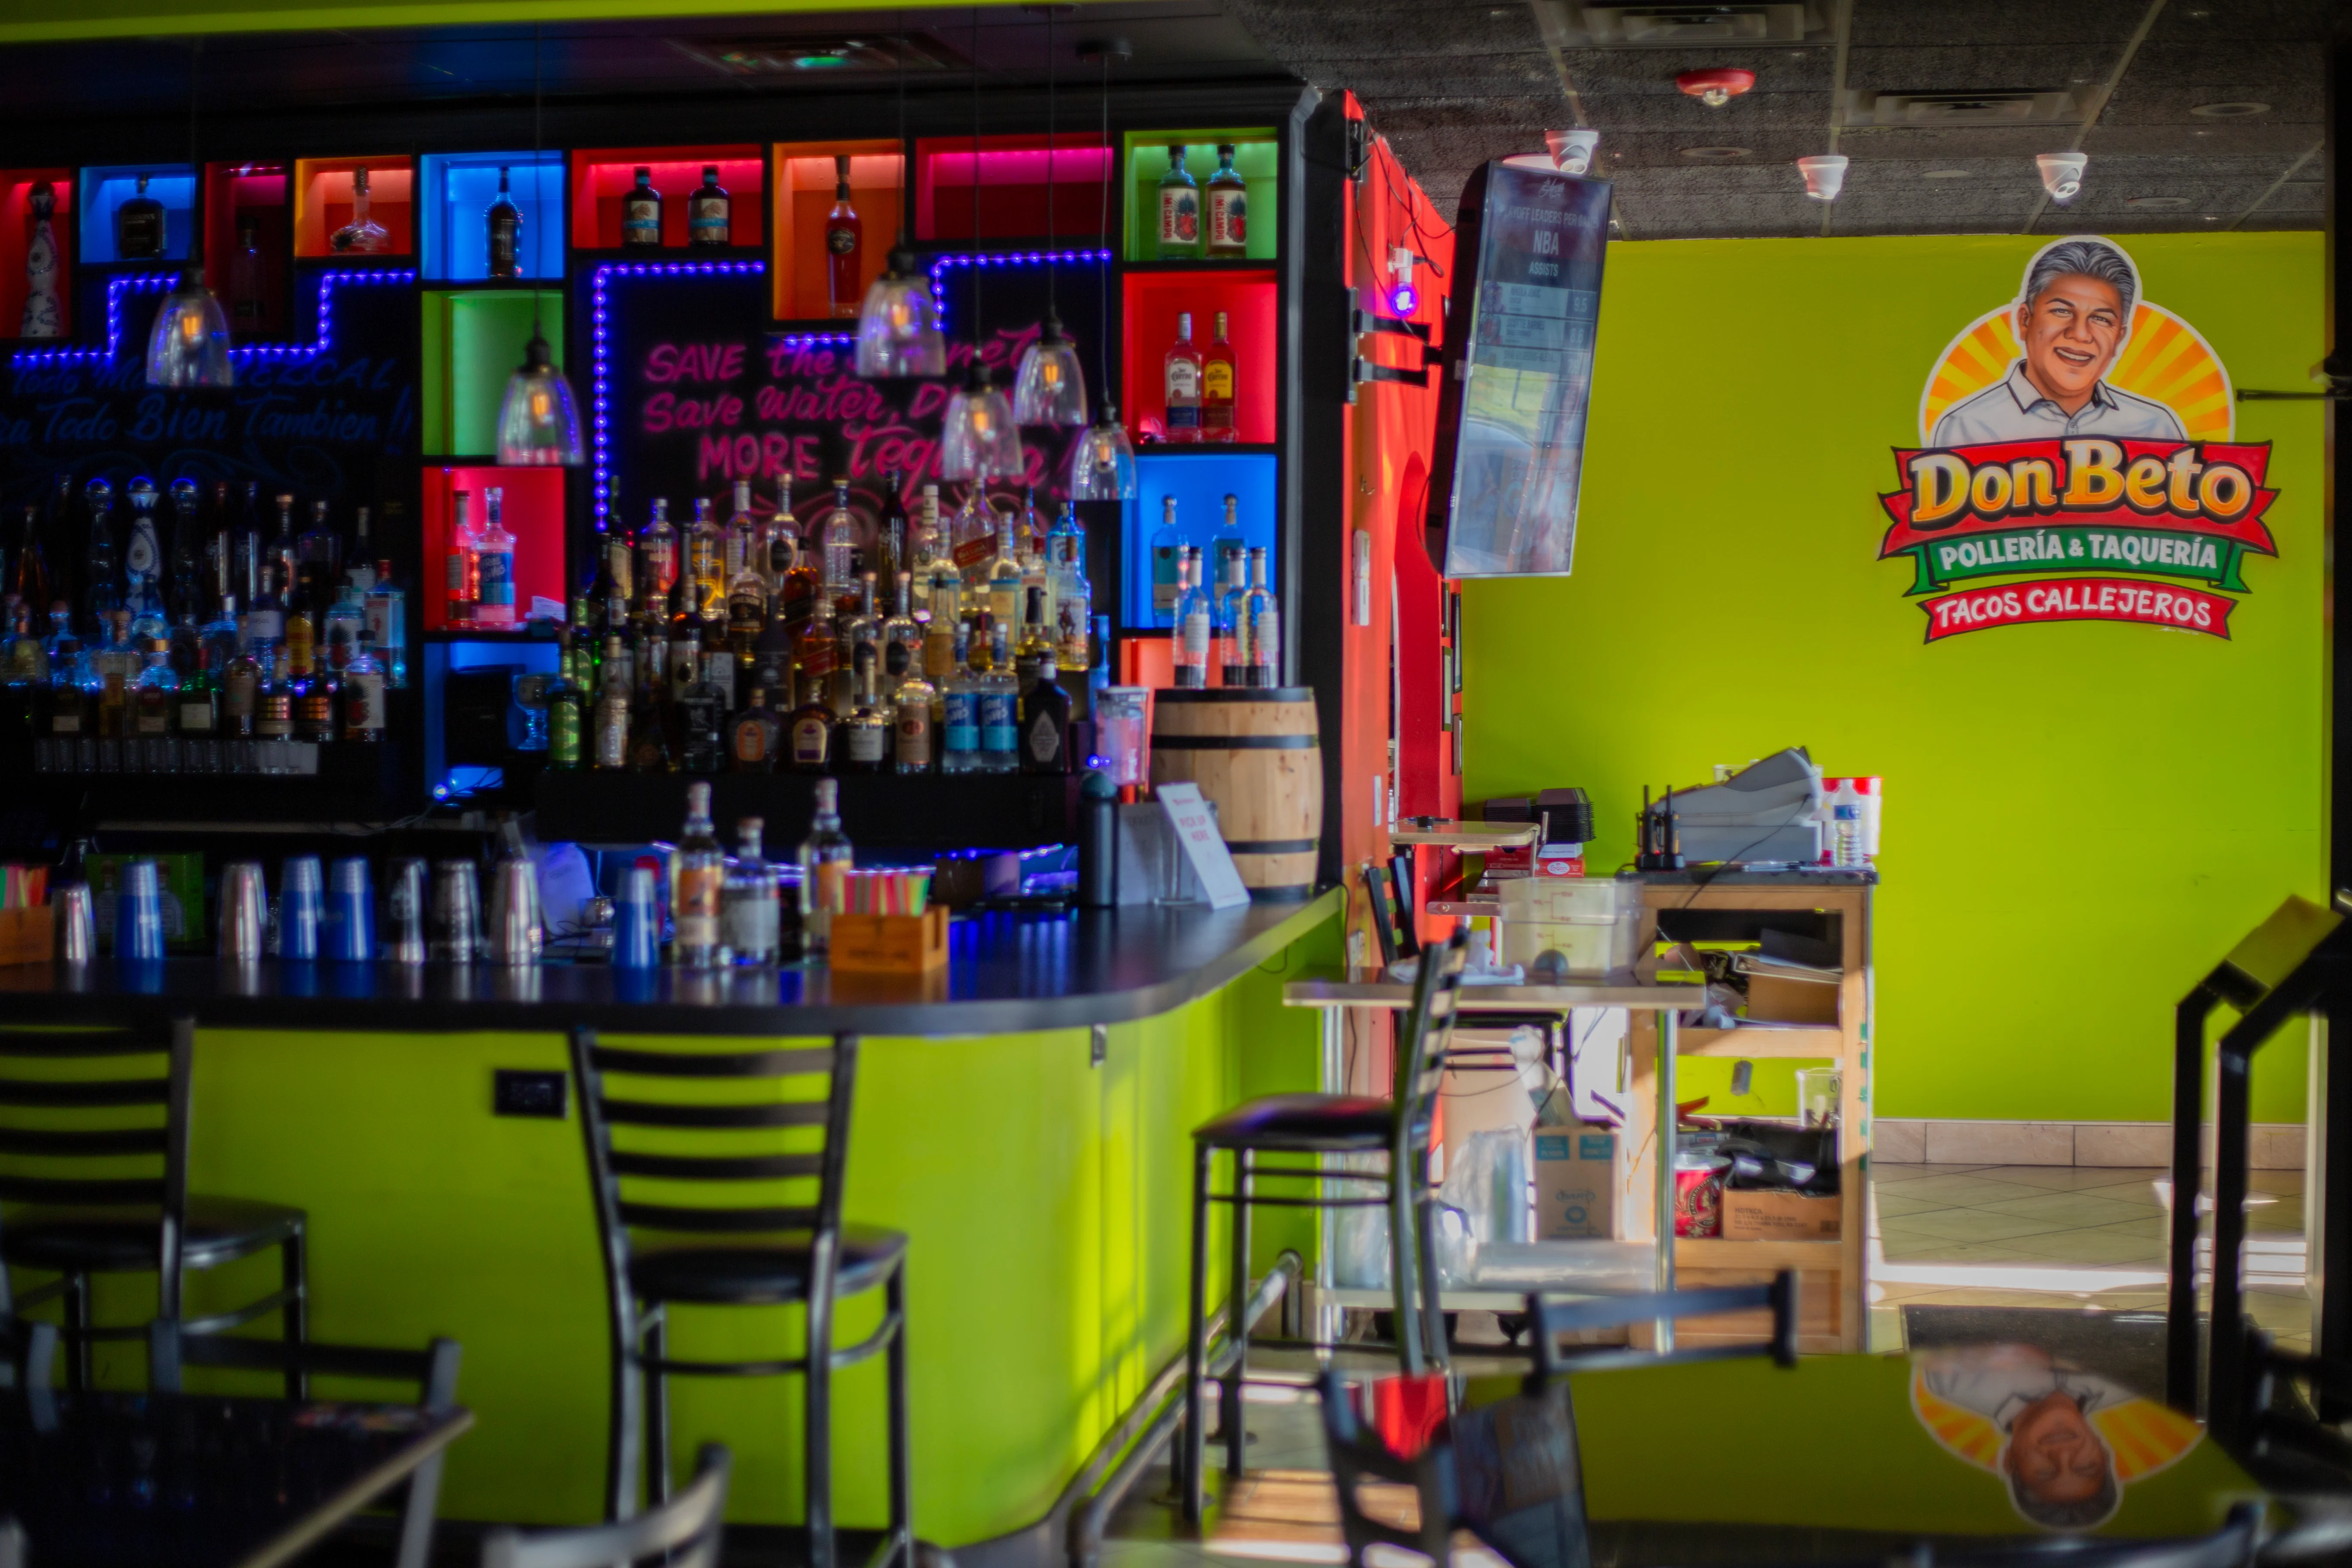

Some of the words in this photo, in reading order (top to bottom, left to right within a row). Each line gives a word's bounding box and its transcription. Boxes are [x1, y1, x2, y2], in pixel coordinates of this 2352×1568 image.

[1164, 209, 1172, 238] CAMPO
[1215, 211, 1225, 240] CAMPO
[1531, 208, 1561, 224] LEADERS
[1563, 212, 1577, 225] PER
[1533, 230, 1559, 255] NBA
[1529, 261, 1559, 276] ASSISTS
[644, 344, 747, 383] SAVE
[766, 342, 834, 379] the
[36, 392, 116, 443] Todo
[127, 392, 228, 442] Bien
[643, 391, 743, 433] Save
[696, 432, 820, 482] MORE
[1912, 453, 2057, 522] Don
[2063, 439, 2251, 516] Beto
[1940, 530, 2065, 570] POLLERÍA
[2068, 539, 2084, 557] &
[2088, 534, 2217, 569] TAQUERÍA
[1936, 592, 2021, 628] TACOS
[2027, 586, 2211, 626] CALLEJEROS
[1191, 829, 1210, 841] HERE
